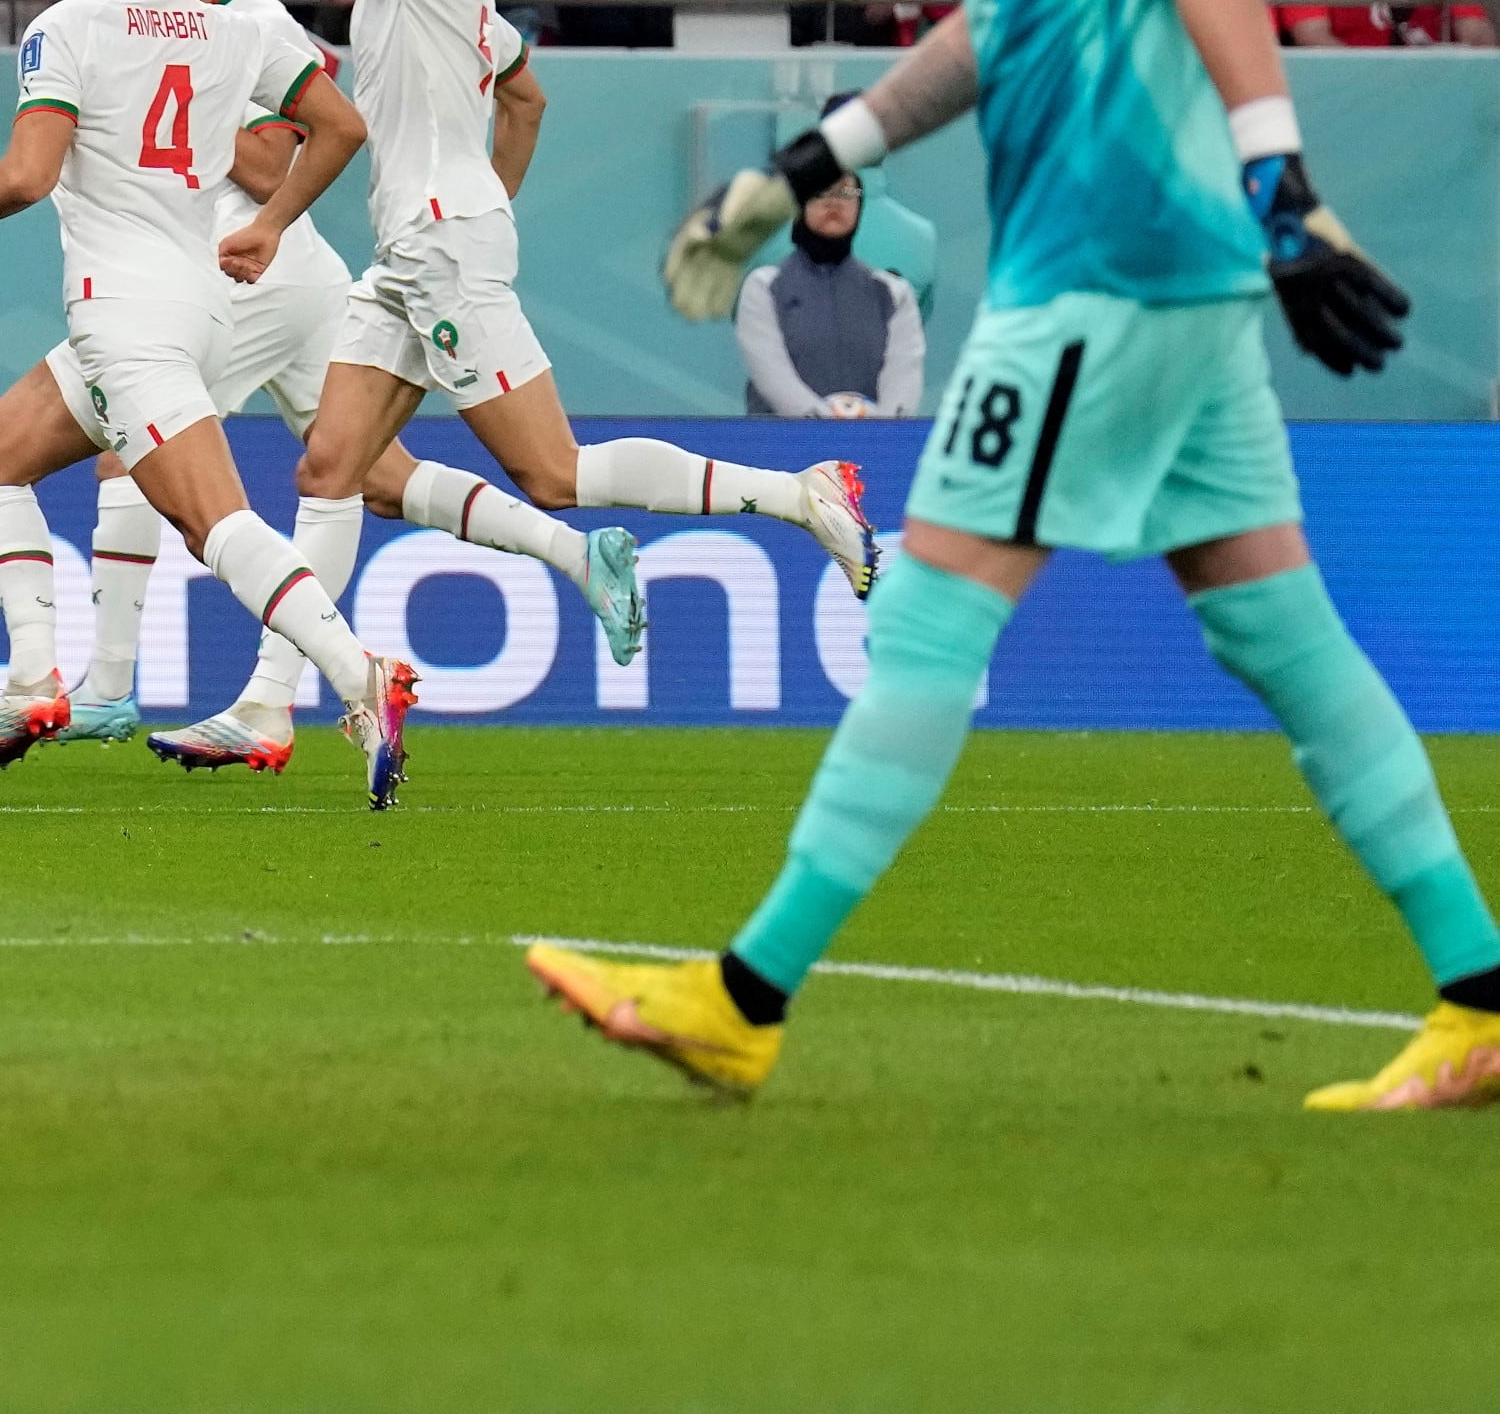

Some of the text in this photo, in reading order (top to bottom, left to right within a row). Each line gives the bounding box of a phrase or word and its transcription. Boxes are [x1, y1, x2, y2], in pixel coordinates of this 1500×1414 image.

[127, 7, 208, 40] AMRABAT
[138, 64, 200, 190] 4
[943, 373, 1022, 473] 18
